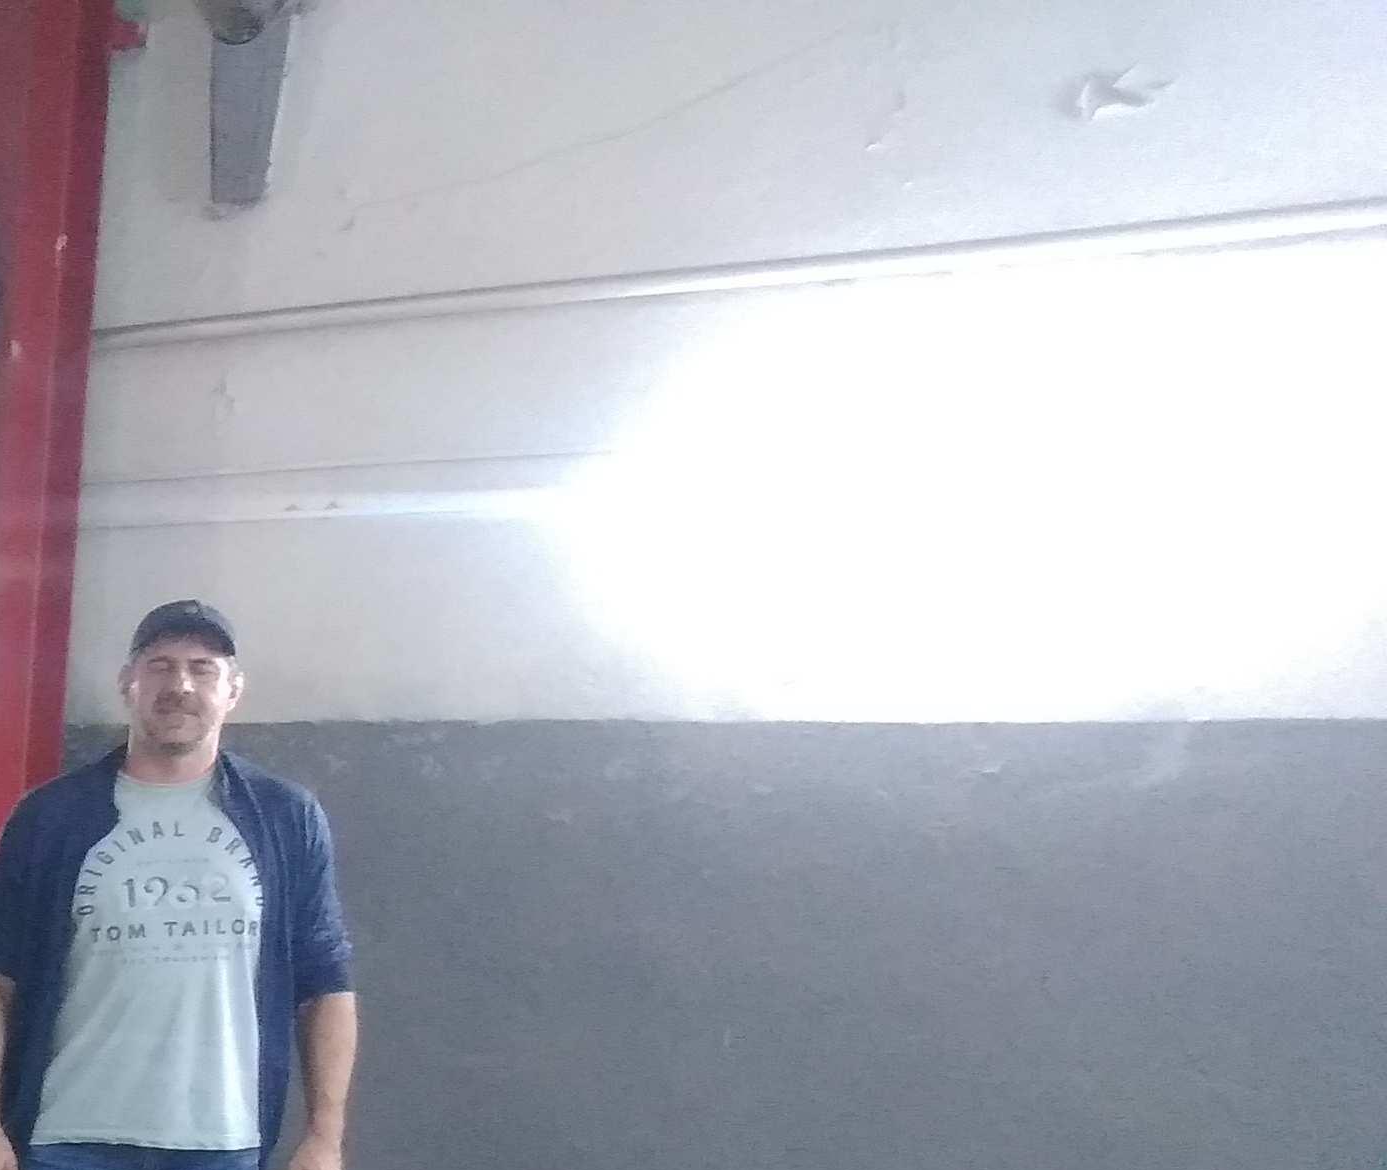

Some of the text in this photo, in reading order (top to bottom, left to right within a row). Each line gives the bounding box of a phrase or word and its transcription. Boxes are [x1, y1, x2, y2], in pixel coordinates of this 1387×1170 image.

[78, 821, 185, 916] ORIGINAL
[91, 919, 258, 942] TOM TAILOR
